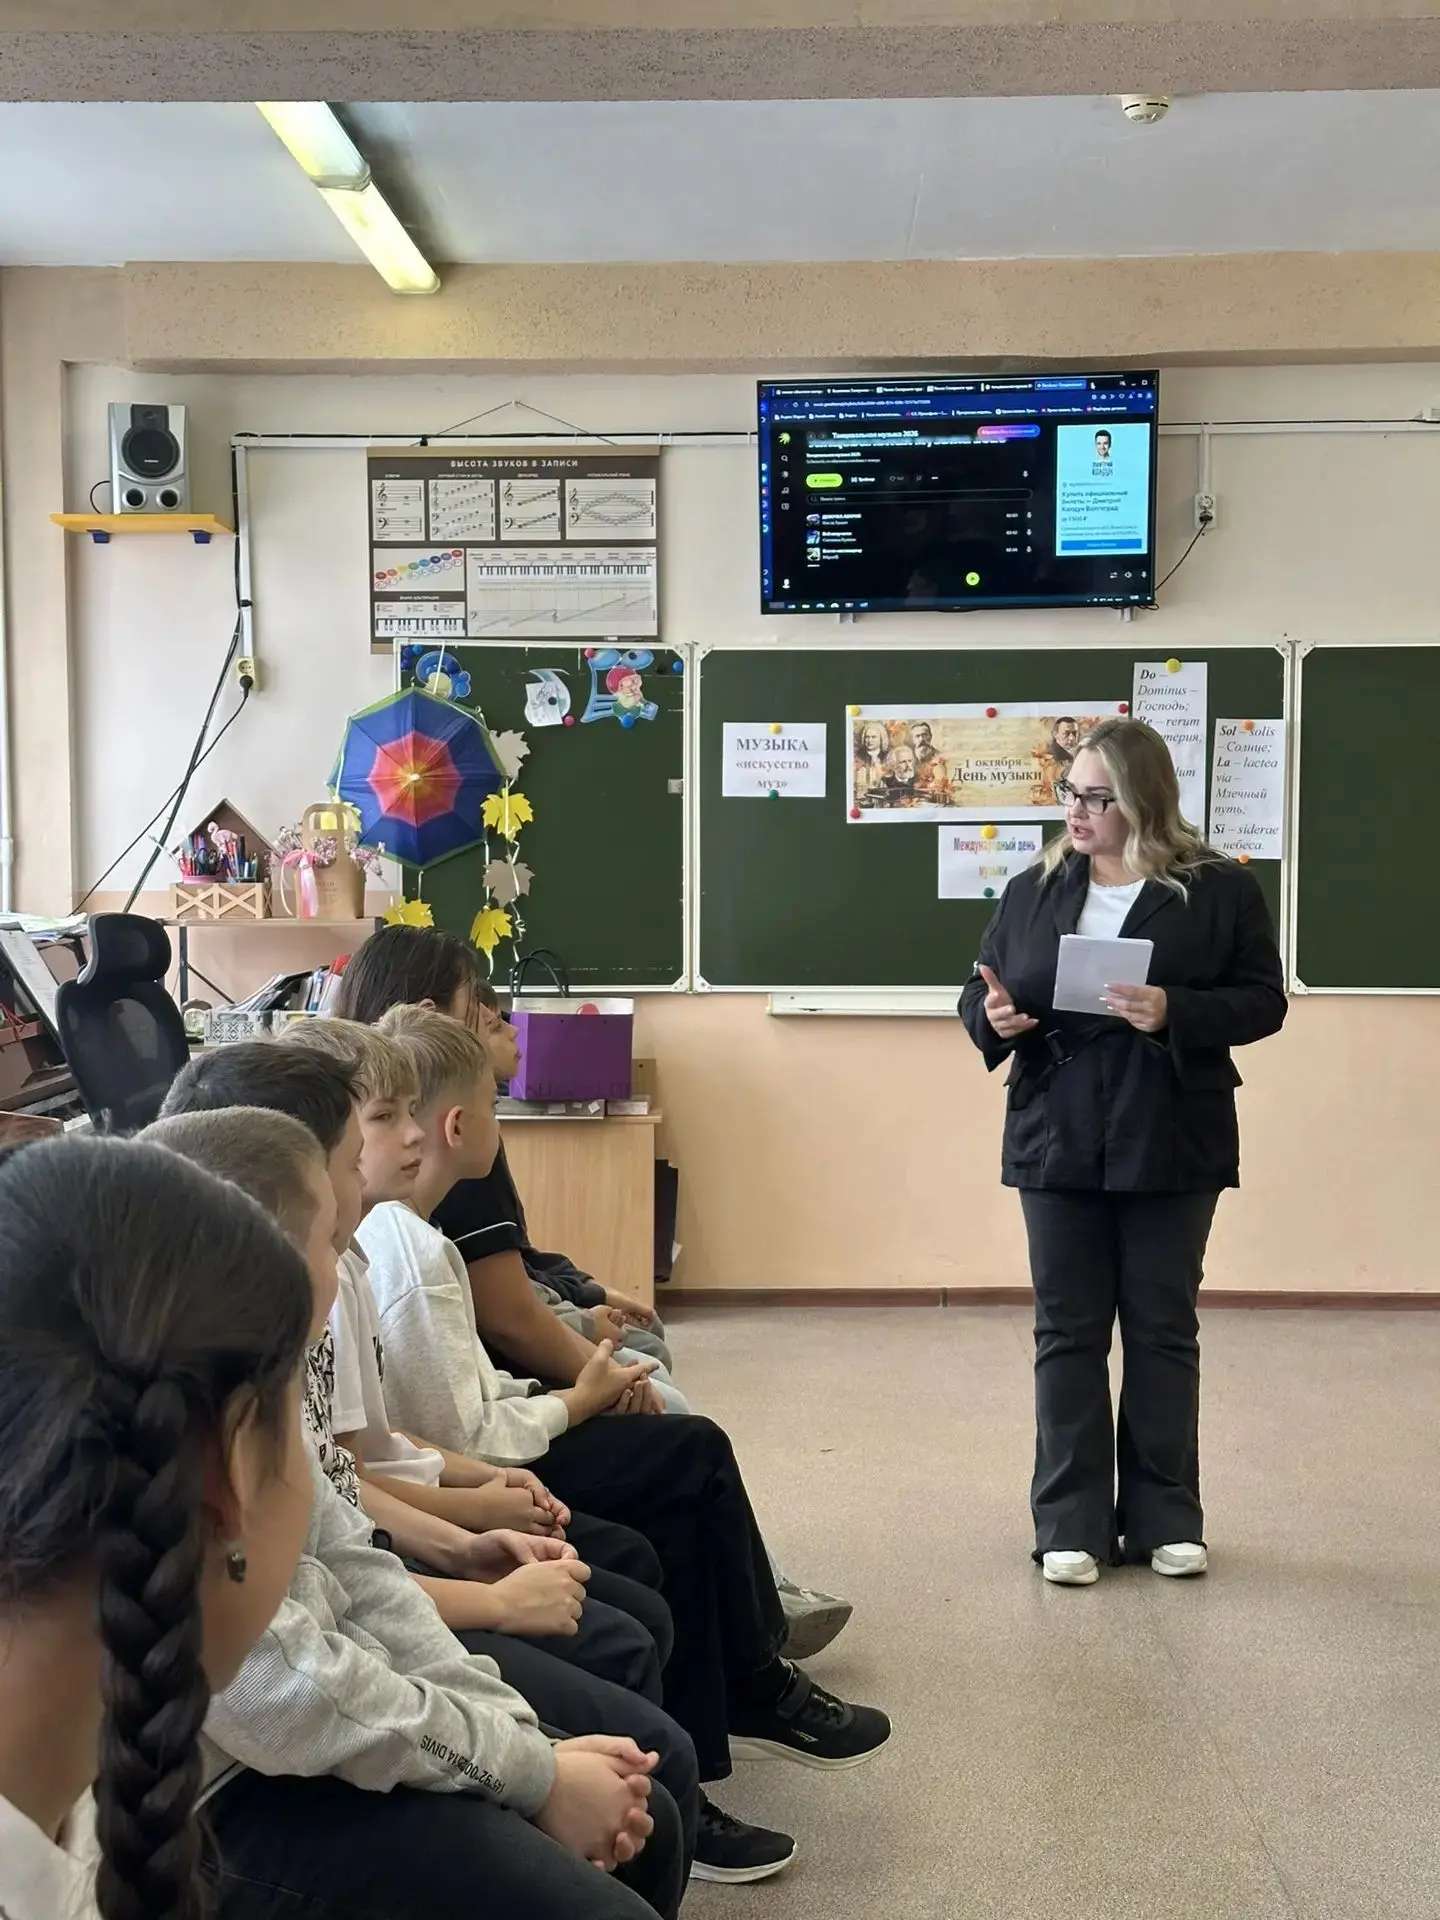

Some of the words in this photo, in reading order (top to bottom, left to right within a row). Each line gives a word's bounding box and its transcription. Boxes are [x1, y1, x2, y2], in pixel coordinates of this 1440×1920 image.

[450, 460, 488, 468] ВЫСОТА
[492, 460, 528, 468] ЗВУКОВ
[532, 460, 538, 468] В
[541, 460, 578, 468] ЗАПИСИ
[1140, 669, 1156, 680] Do
[1137, 685, 1187, 696] Dominus
[1166, 717, 1201, 727] rerum
[1220, 725, 1237, 737] Sol
[1248, 726, 1276, 737] solis
[736, 738, 809, 751] МУЗЫКА
[1226, 741, 1273, 753] Солнце;
[736, 760, 809, 773] «искусство
[975, 756, 1022, 770] октября
[1217, 757, 1231, 768] La
[1243, 757, 1278, 768] lactea
[951, 768, 987, 783] День
[990, 771, 1042, 784] музыки
[1216, 774, 1232, 783] via
[757, 780, 788, 791] муз»
[1216, 788, 1267, 799] Млечный
[1213, 824, 1225, 834] Si
[1237, 824, 1279, 835] siderae
[1018, 841, 1036, 854] день
[979, 866, 1008, 879] музыки
